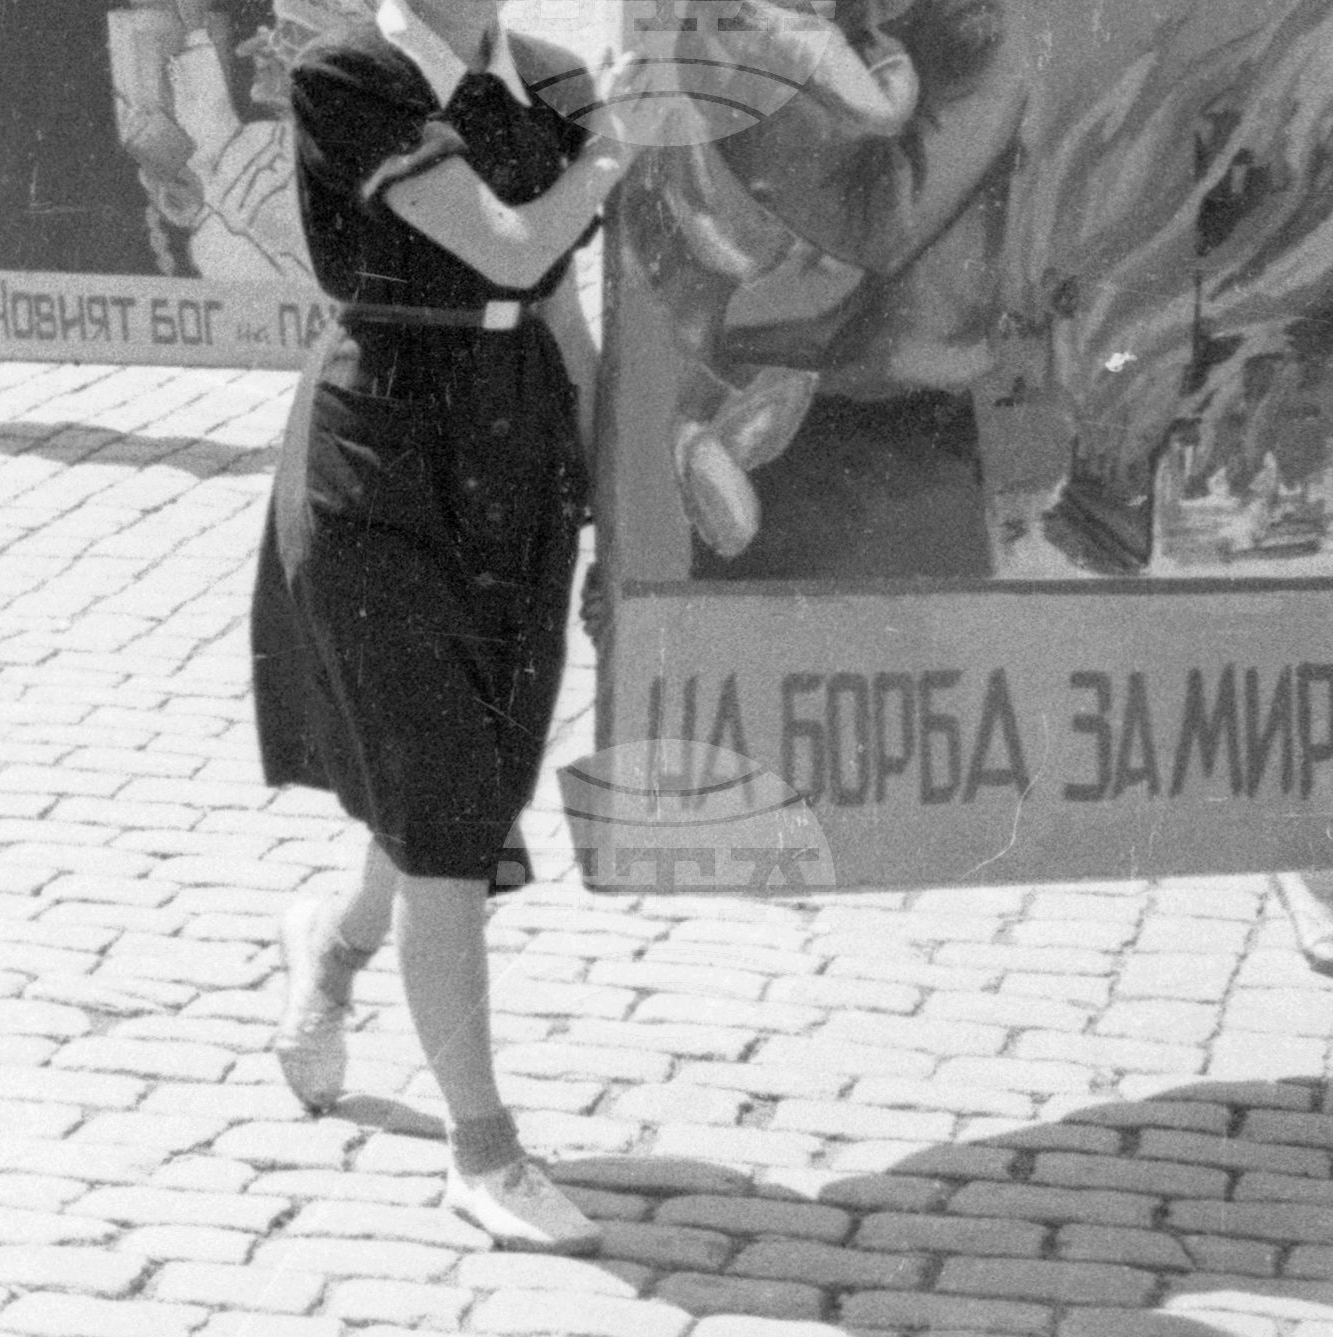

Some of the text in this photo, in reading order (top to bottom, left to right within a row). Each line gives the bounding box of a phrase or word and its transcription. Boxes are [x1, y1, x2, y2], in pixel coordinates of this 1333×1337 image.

[151, 298, 223, 345] БОГ
[279, 302, 331, 350] ПА
[780, 667, 1030, 807] БОРБА
[1063, 670, 1161, 802] ЗА
[1169, 662, 1333, 800] МИР
